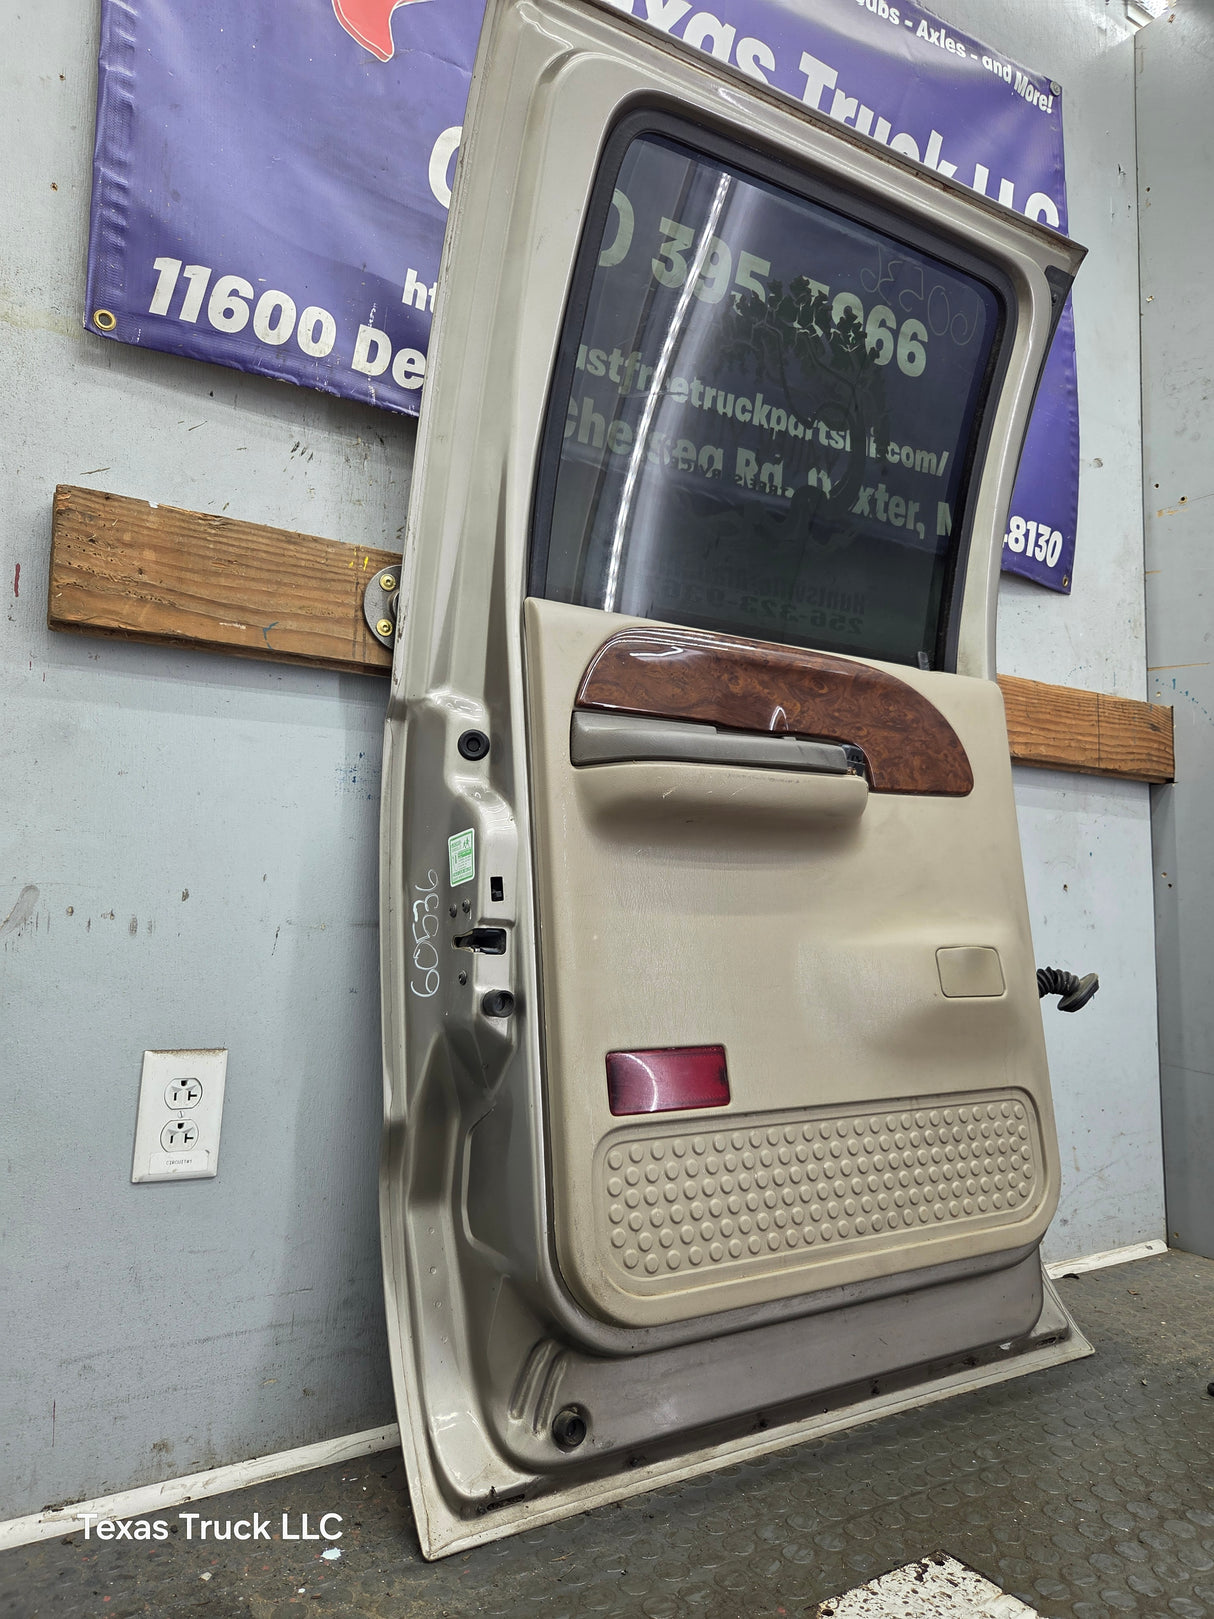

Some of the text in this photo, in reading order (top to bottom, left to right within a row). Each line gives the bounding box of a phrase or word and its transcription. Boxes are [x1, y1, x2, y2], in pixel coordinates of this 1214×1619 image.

[856, 0, 900, 25] ubs
[916, 19, 967, 58] Axles
[982, 55, 1012, 84] and
[1013, 71, 1054, 114] More!
[149, 256, 336, 358] 11600
[1002, 515, 1063, 568] 8130
[411, 869, 440, 997] 60536
